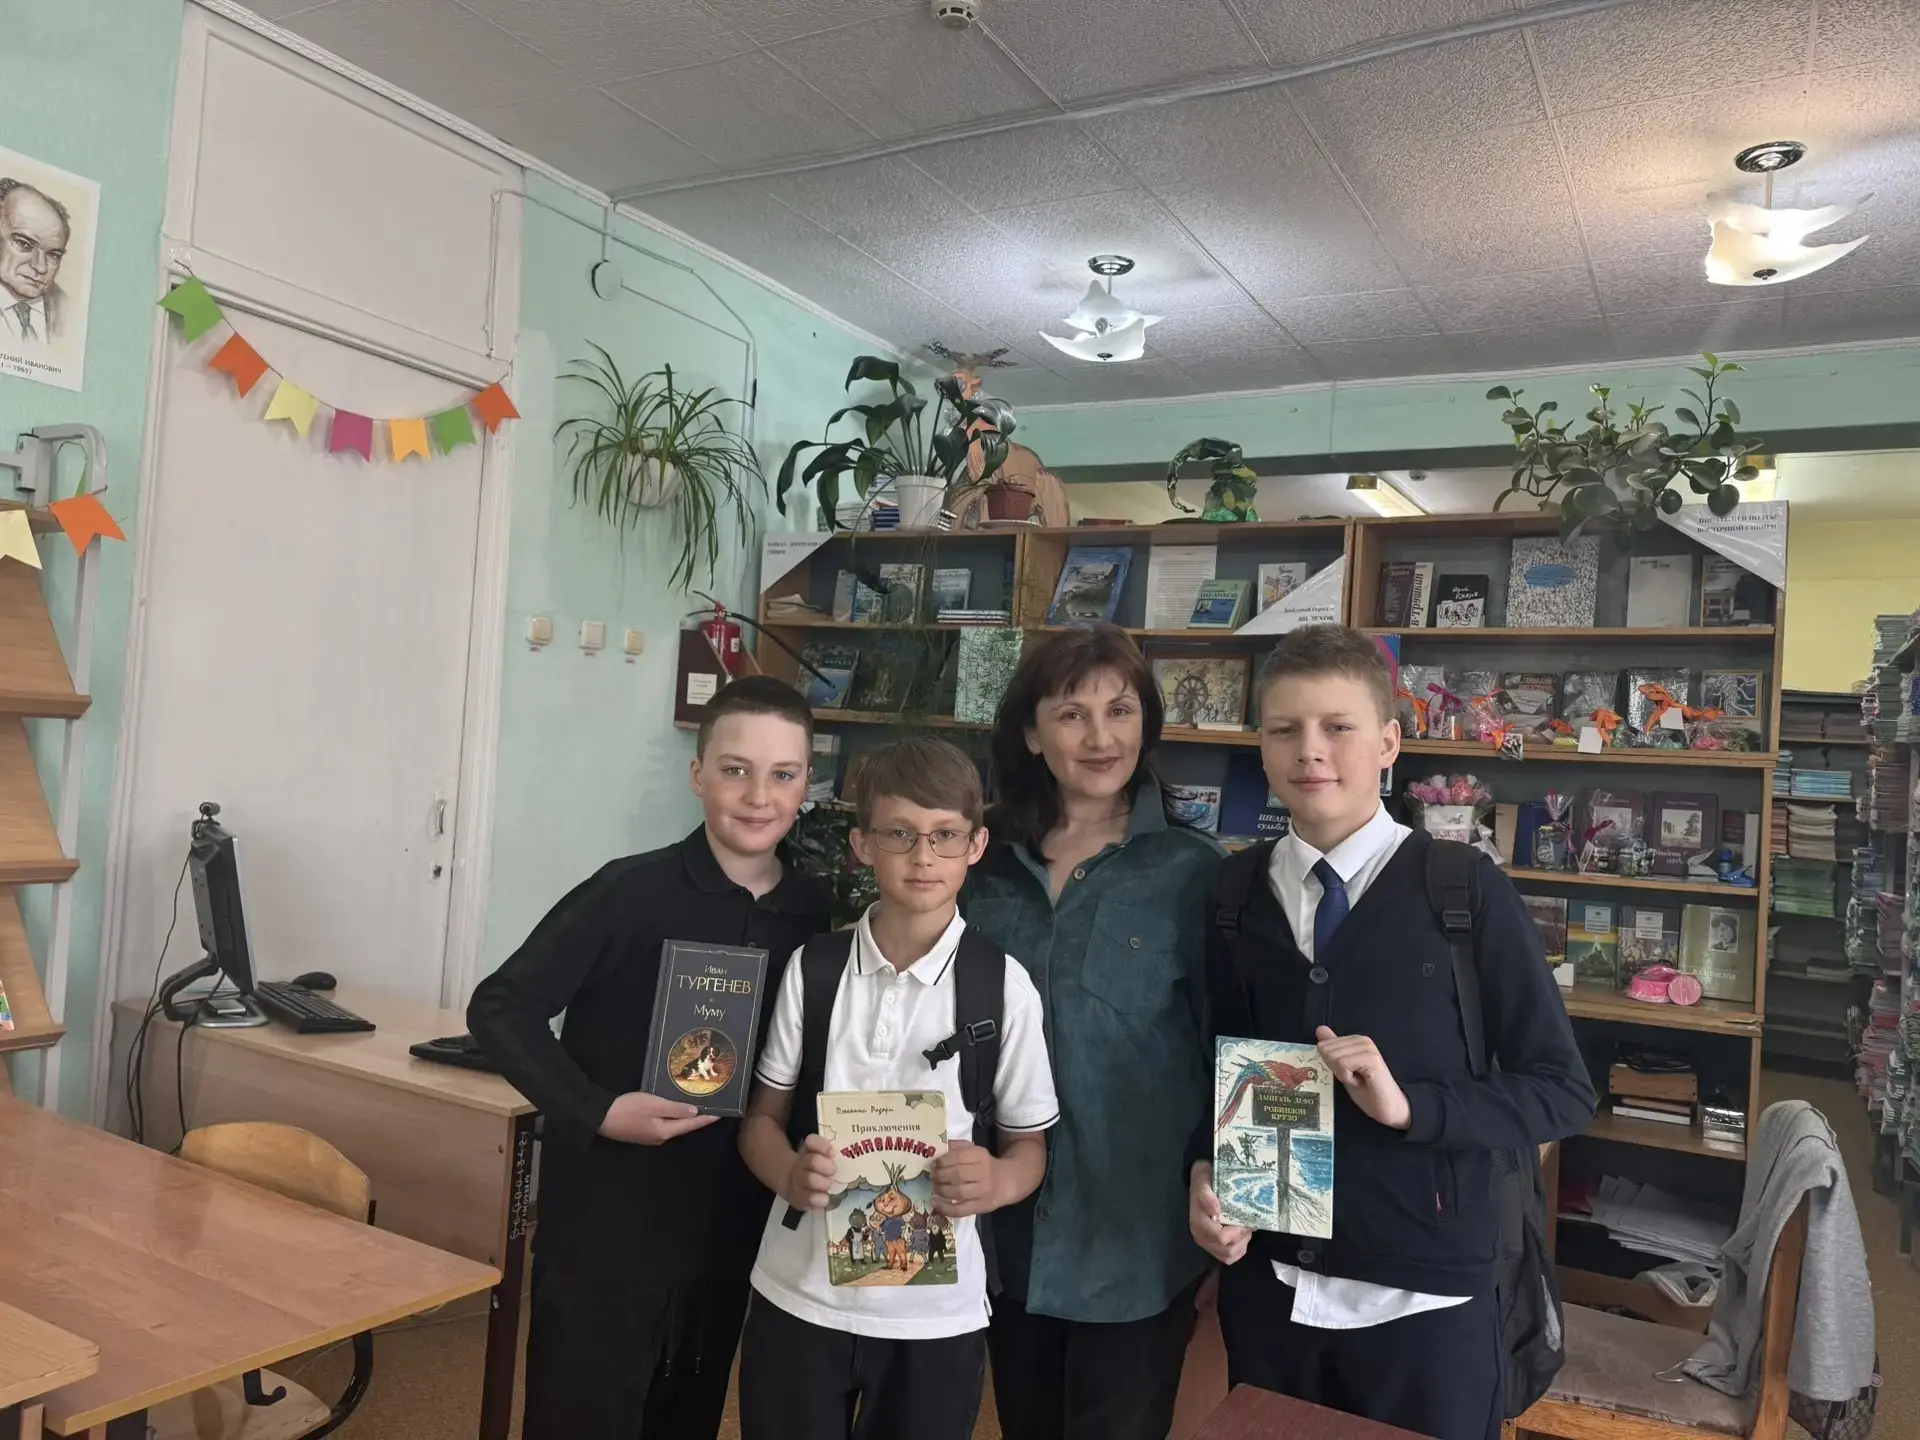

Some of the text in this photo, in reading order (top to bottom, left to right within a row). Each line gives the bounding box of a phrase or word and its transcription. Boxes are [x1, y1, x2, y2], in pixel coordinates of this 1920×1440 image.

[13, 365, 32, 376] 1965)
[25, 359, 62, 374] ИВАНОВИЧ
[704, 964, 727, 975] Иван
[676, 974, 752, 995] ТУРГЕНЕВ
[693, 1002, 727, 1021] Муму
[1263, 1105, 1306, 1115] РОБИНЗОН
[1271, 1113, 1298, 1122] КРУЗО
[851, 1124, 921, 1135] Приключения
[839, 1136, 937, 1160] ЧИПОЛЛИНО
